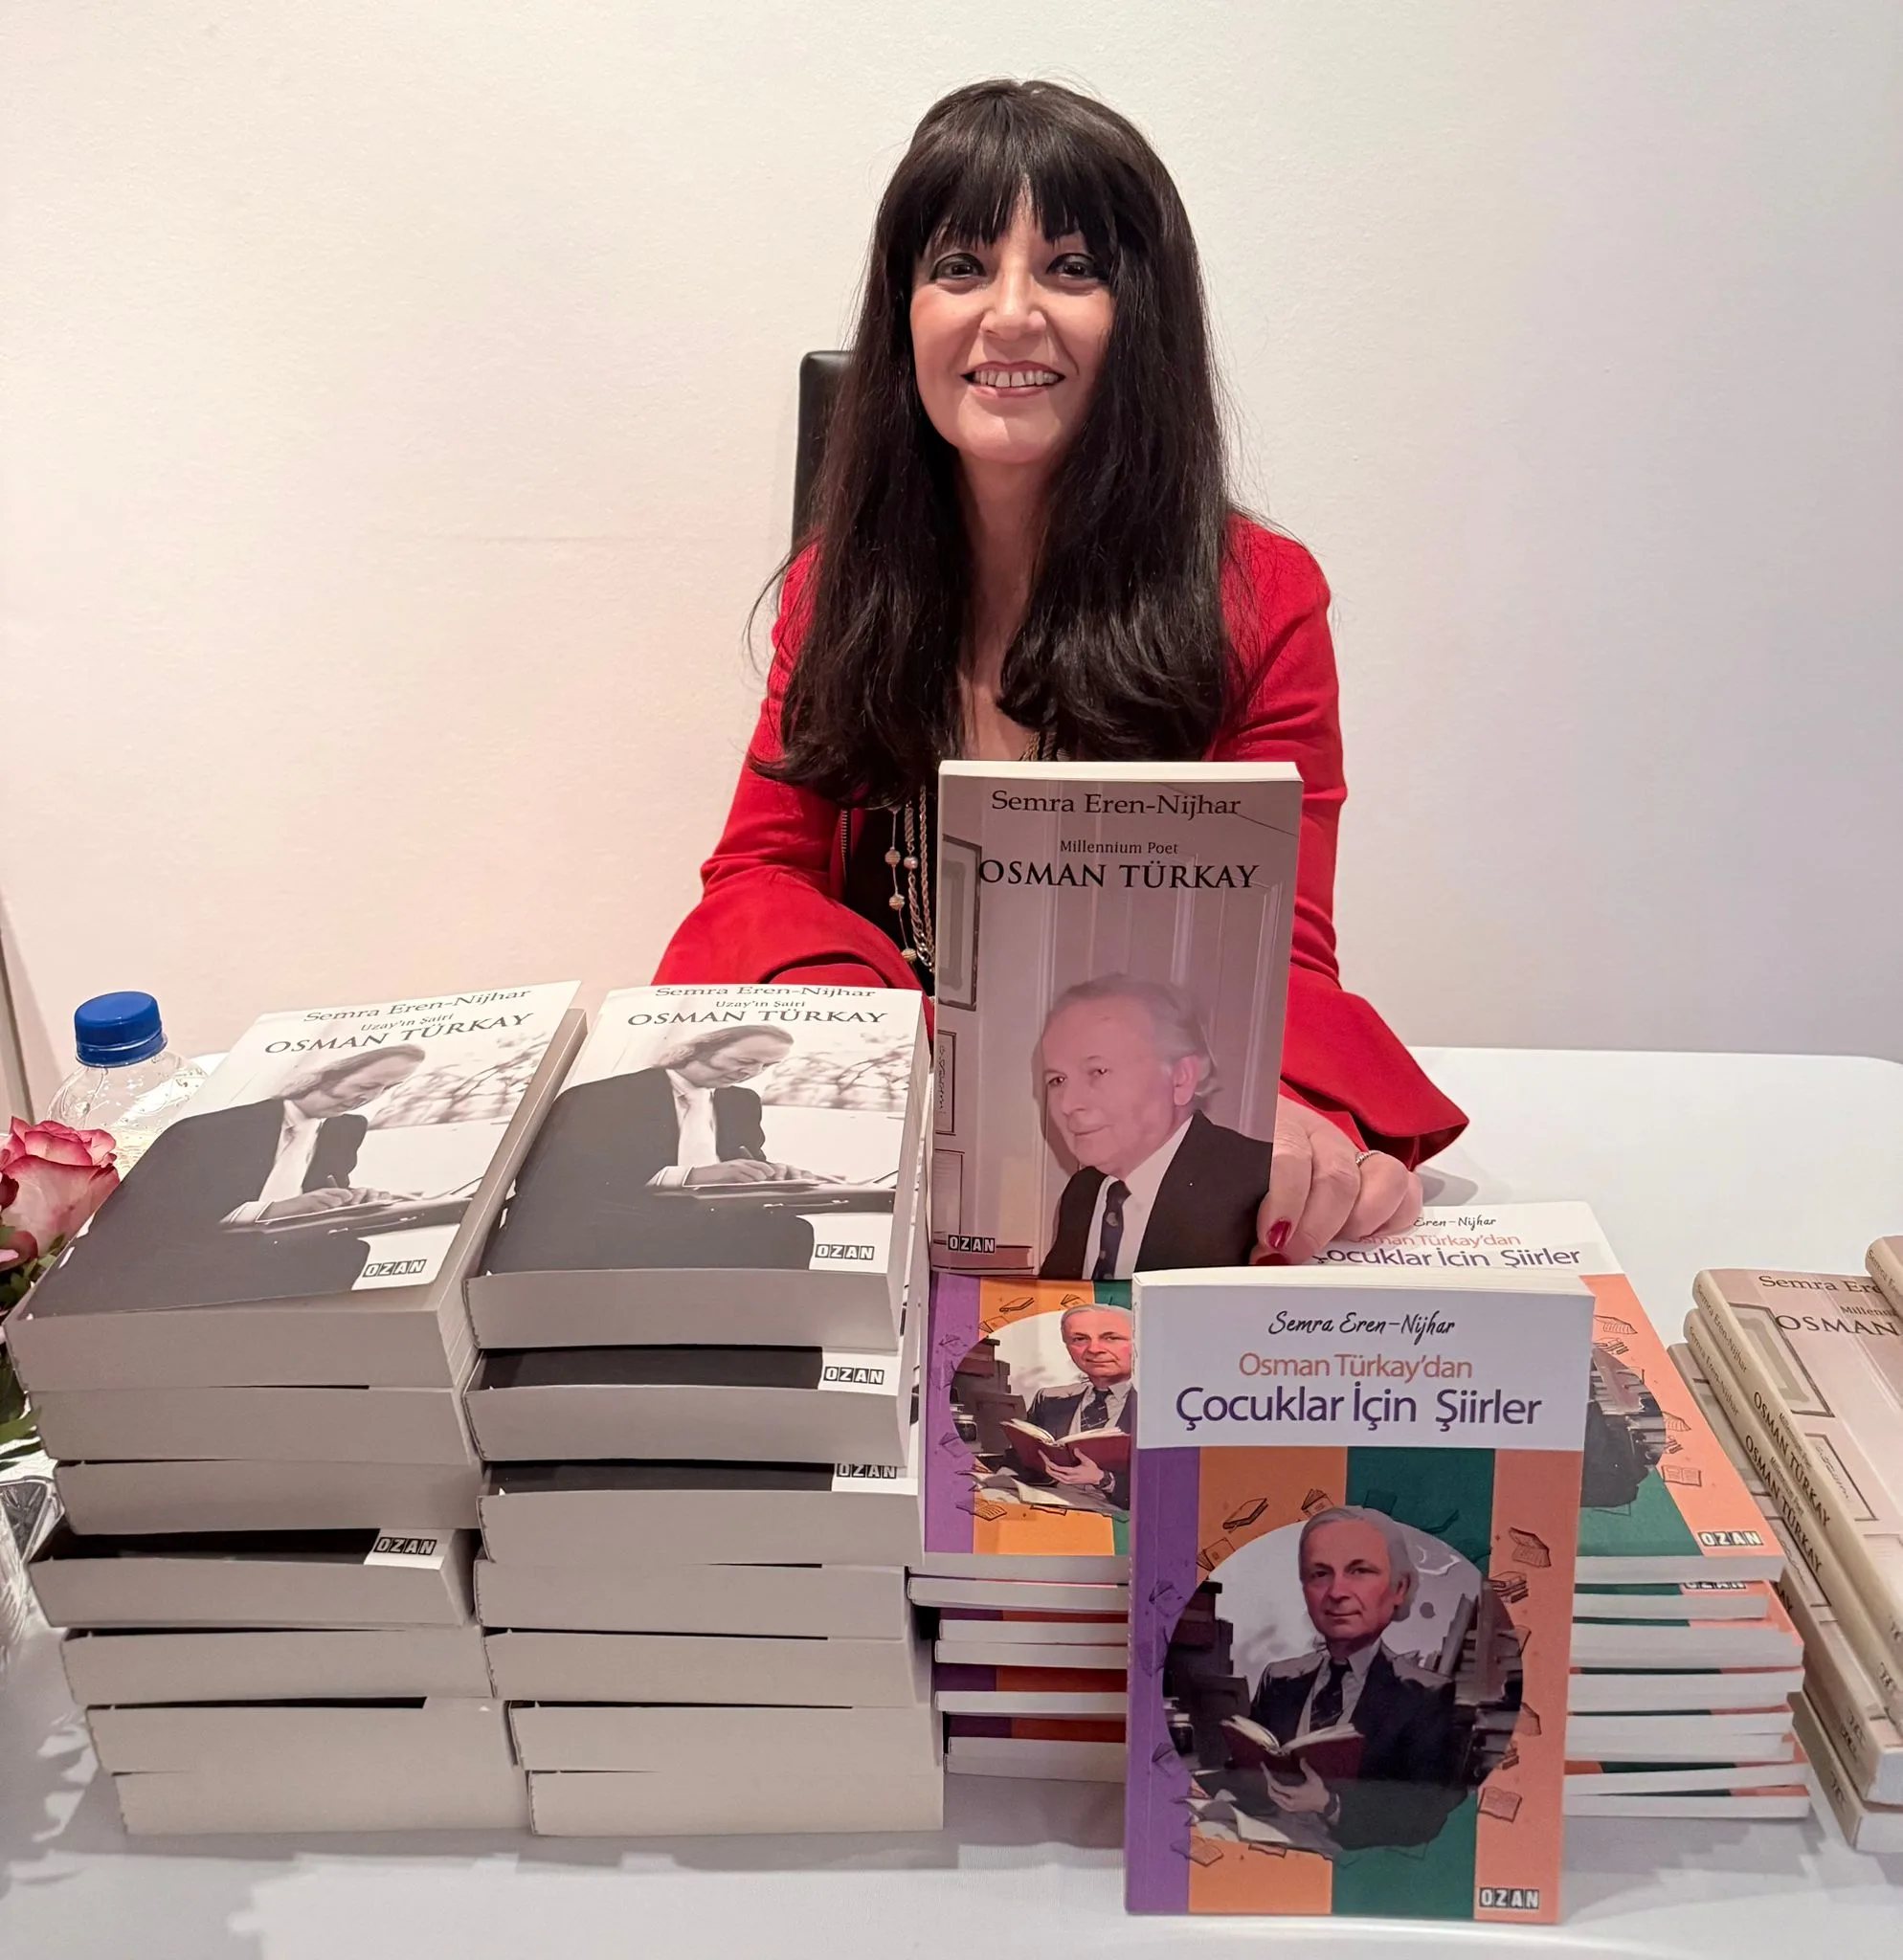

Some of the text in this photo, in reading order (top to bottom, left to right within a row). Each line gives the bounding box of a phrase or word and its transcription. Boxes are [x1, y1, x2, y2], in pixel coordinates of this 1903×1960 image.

[992, 790, 1241, 821] Semra Eren-Nijhar
[1060, 839, 1178, 855] Millennium Poet
[978, 858, 1260, 889] OSMAN TÜRKAY
[656, 986, 876, 998] Semra Eren-Nijhar
[303, 990, 532, 1022] Semra Eren-Nijhar
[628, 1008, 888, 1026] OSMAN TÜRKAY
[264, 1013, 535, 1054] OSMAN TÜRKAY
[948, 1235, 995, 1253] OZAN
[1347, 1234, 1522, 1249] sman Türkay'dan
[815, 1244, 875, 1260] OZAN
[1311, 1247, 1432, 1266] ocuklar
[1501, 1247, 1580, 1269] Şiirler
[363, 1259, 427, 1278] OZAN
[1758, 1275, 1839, 1291] Semra
[1268, 1310, 1456, 1345] Semra Eren-Nijhar
[1775, 1315, 1900, 1337] OSMAN
[823, 1366, 884, 1385] OZAN
[1239, 1352, 1473, 1384] Osman Türkay'dan
[1175, 1381, 1542, 1432] Çocuklar İçin Şiirler
[1754, 1392, 1789, 1457] OSMAN
[836, 1463, 897, 1479] OZAN
[1745, 1436, 1780, 1501] OSMAN
[373, 1537, 437, 1555] OZAN
[1698, 1531, 1763, 1547] OZAN
[1479, 1887, 1539, 1909] OZAN
